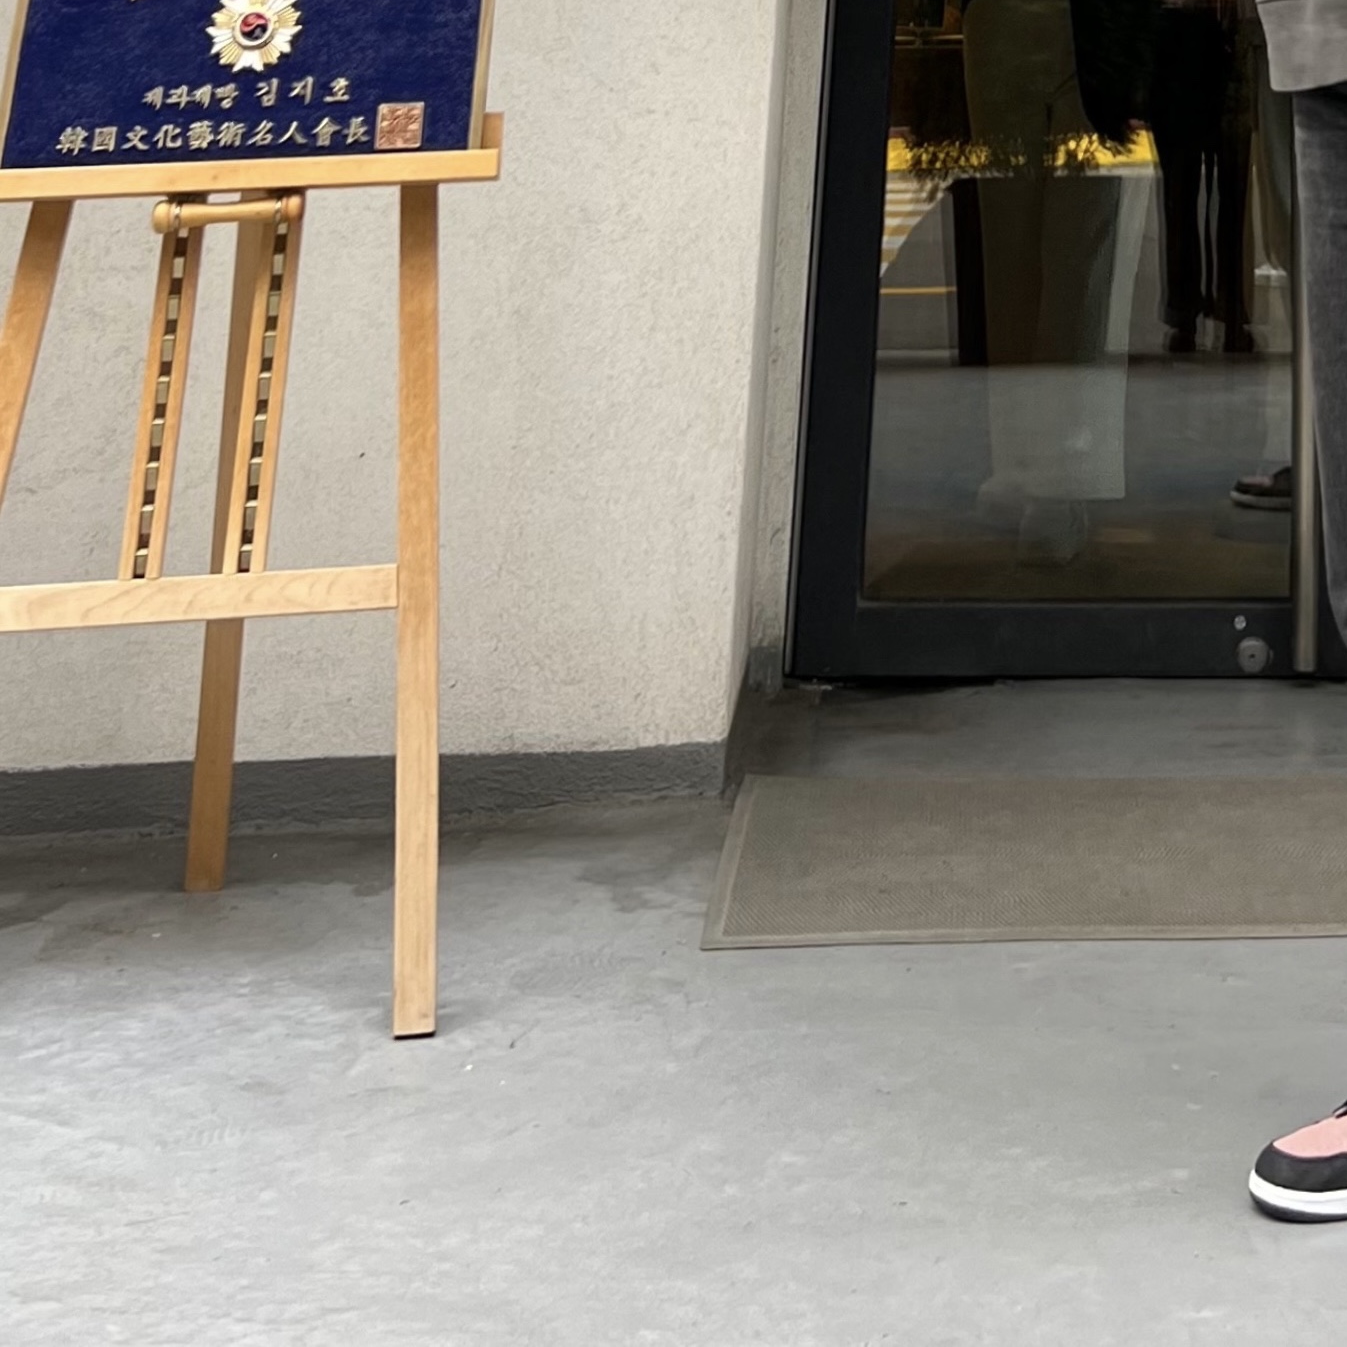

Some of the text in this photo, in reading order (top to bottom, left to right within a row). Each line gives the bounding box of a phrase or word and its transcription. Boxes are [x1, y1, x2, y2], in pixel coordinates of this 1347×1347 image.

[142, 83, 240, 110] 제과제빵
[56, 116, 372, 156] 韓國文化藝術名人會長
